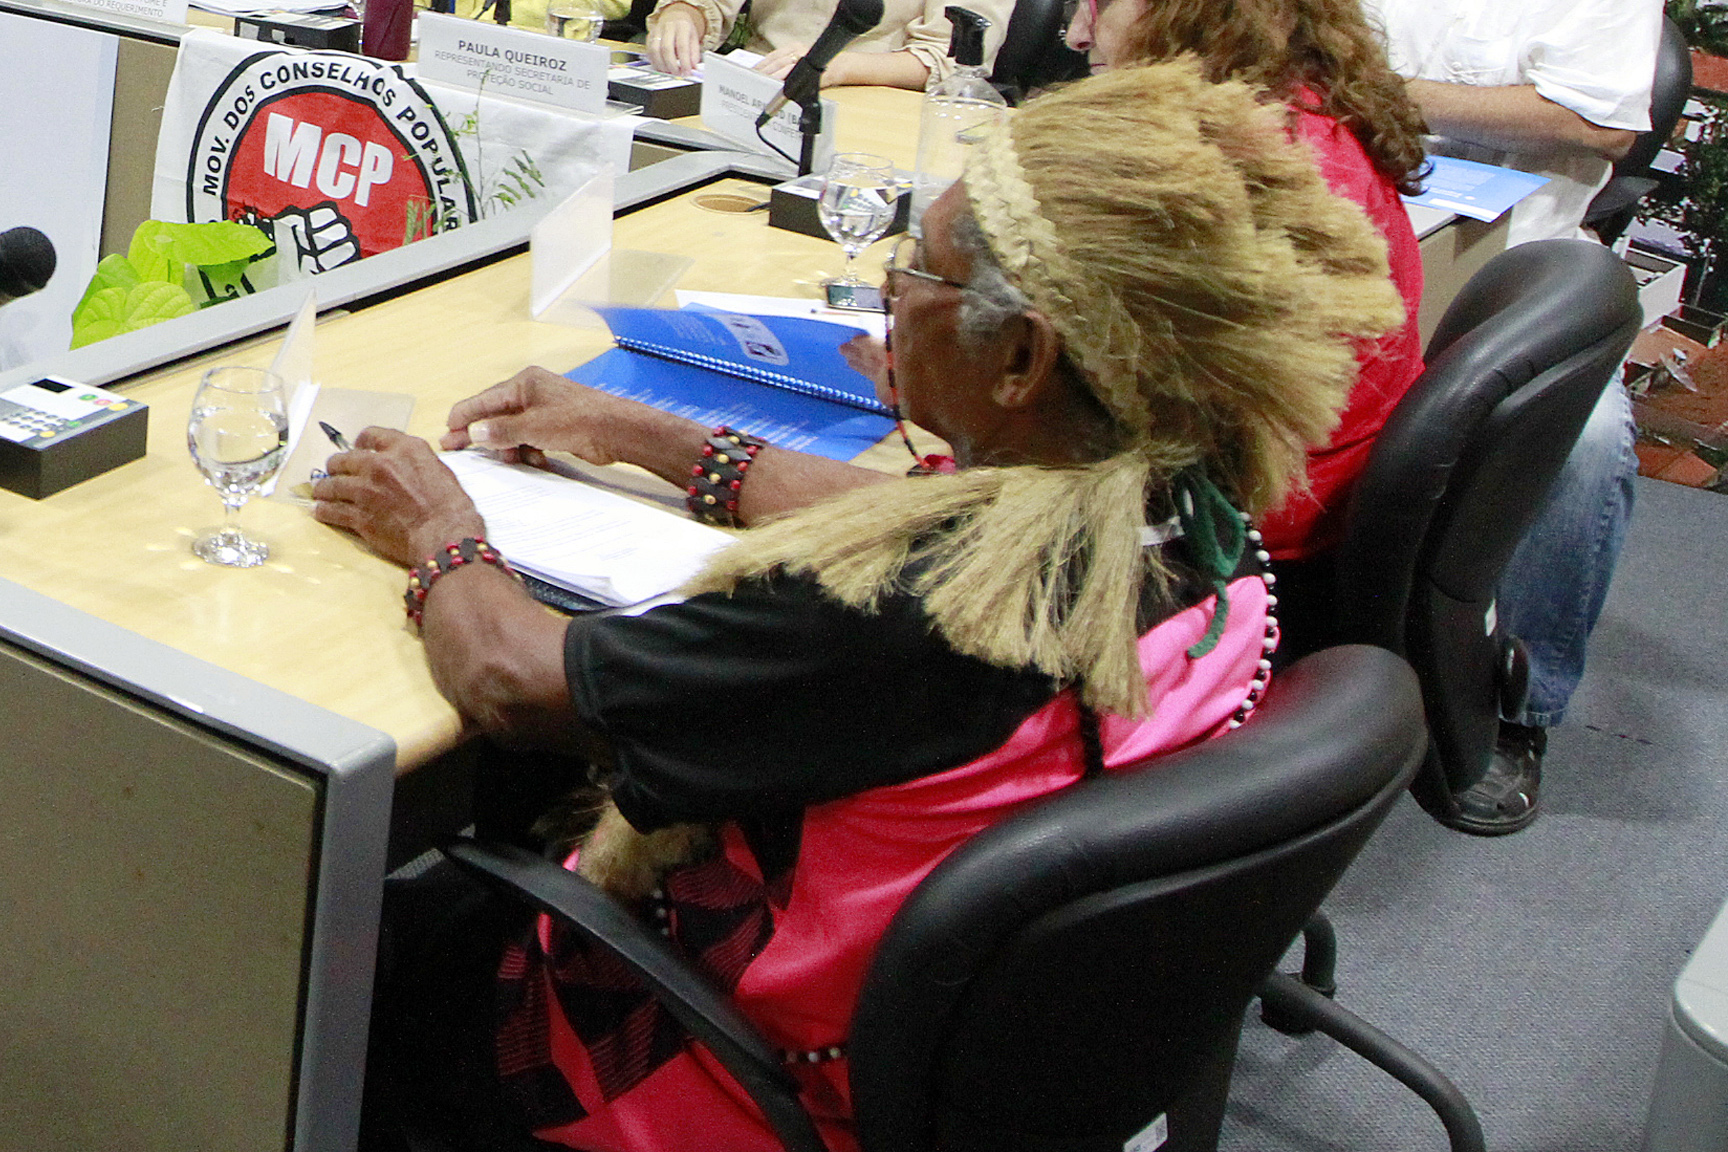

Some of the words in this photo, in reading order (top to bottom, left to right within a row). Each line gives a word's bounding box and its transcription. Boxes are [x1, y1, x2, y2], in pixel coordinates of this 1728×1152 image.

[106, 0, 164, 18] REQUERIMENTO
[434, 50, 512, 73] REPRESENTANDO
[515, 67, 574, 86] SECRETARIA
[577, 78, 590, 90] DE
[458, 40, 501, 58] PAULA
[504, 49, 567, 72] QUEIROZ
[467, 69, 515, 87] PROTEÇÃO
[518, 80, 554, 95] SOCIAL
[719, 84, 750, 105] MANOEL
[203, 136, 231, 196] MOV.
[223, 85, 255, 131] DOS
[260, 62, 397, 107] CONSELHOS
[396, 106, 459, 233] POPULAR
[264, 112, 394, 207] MCP
